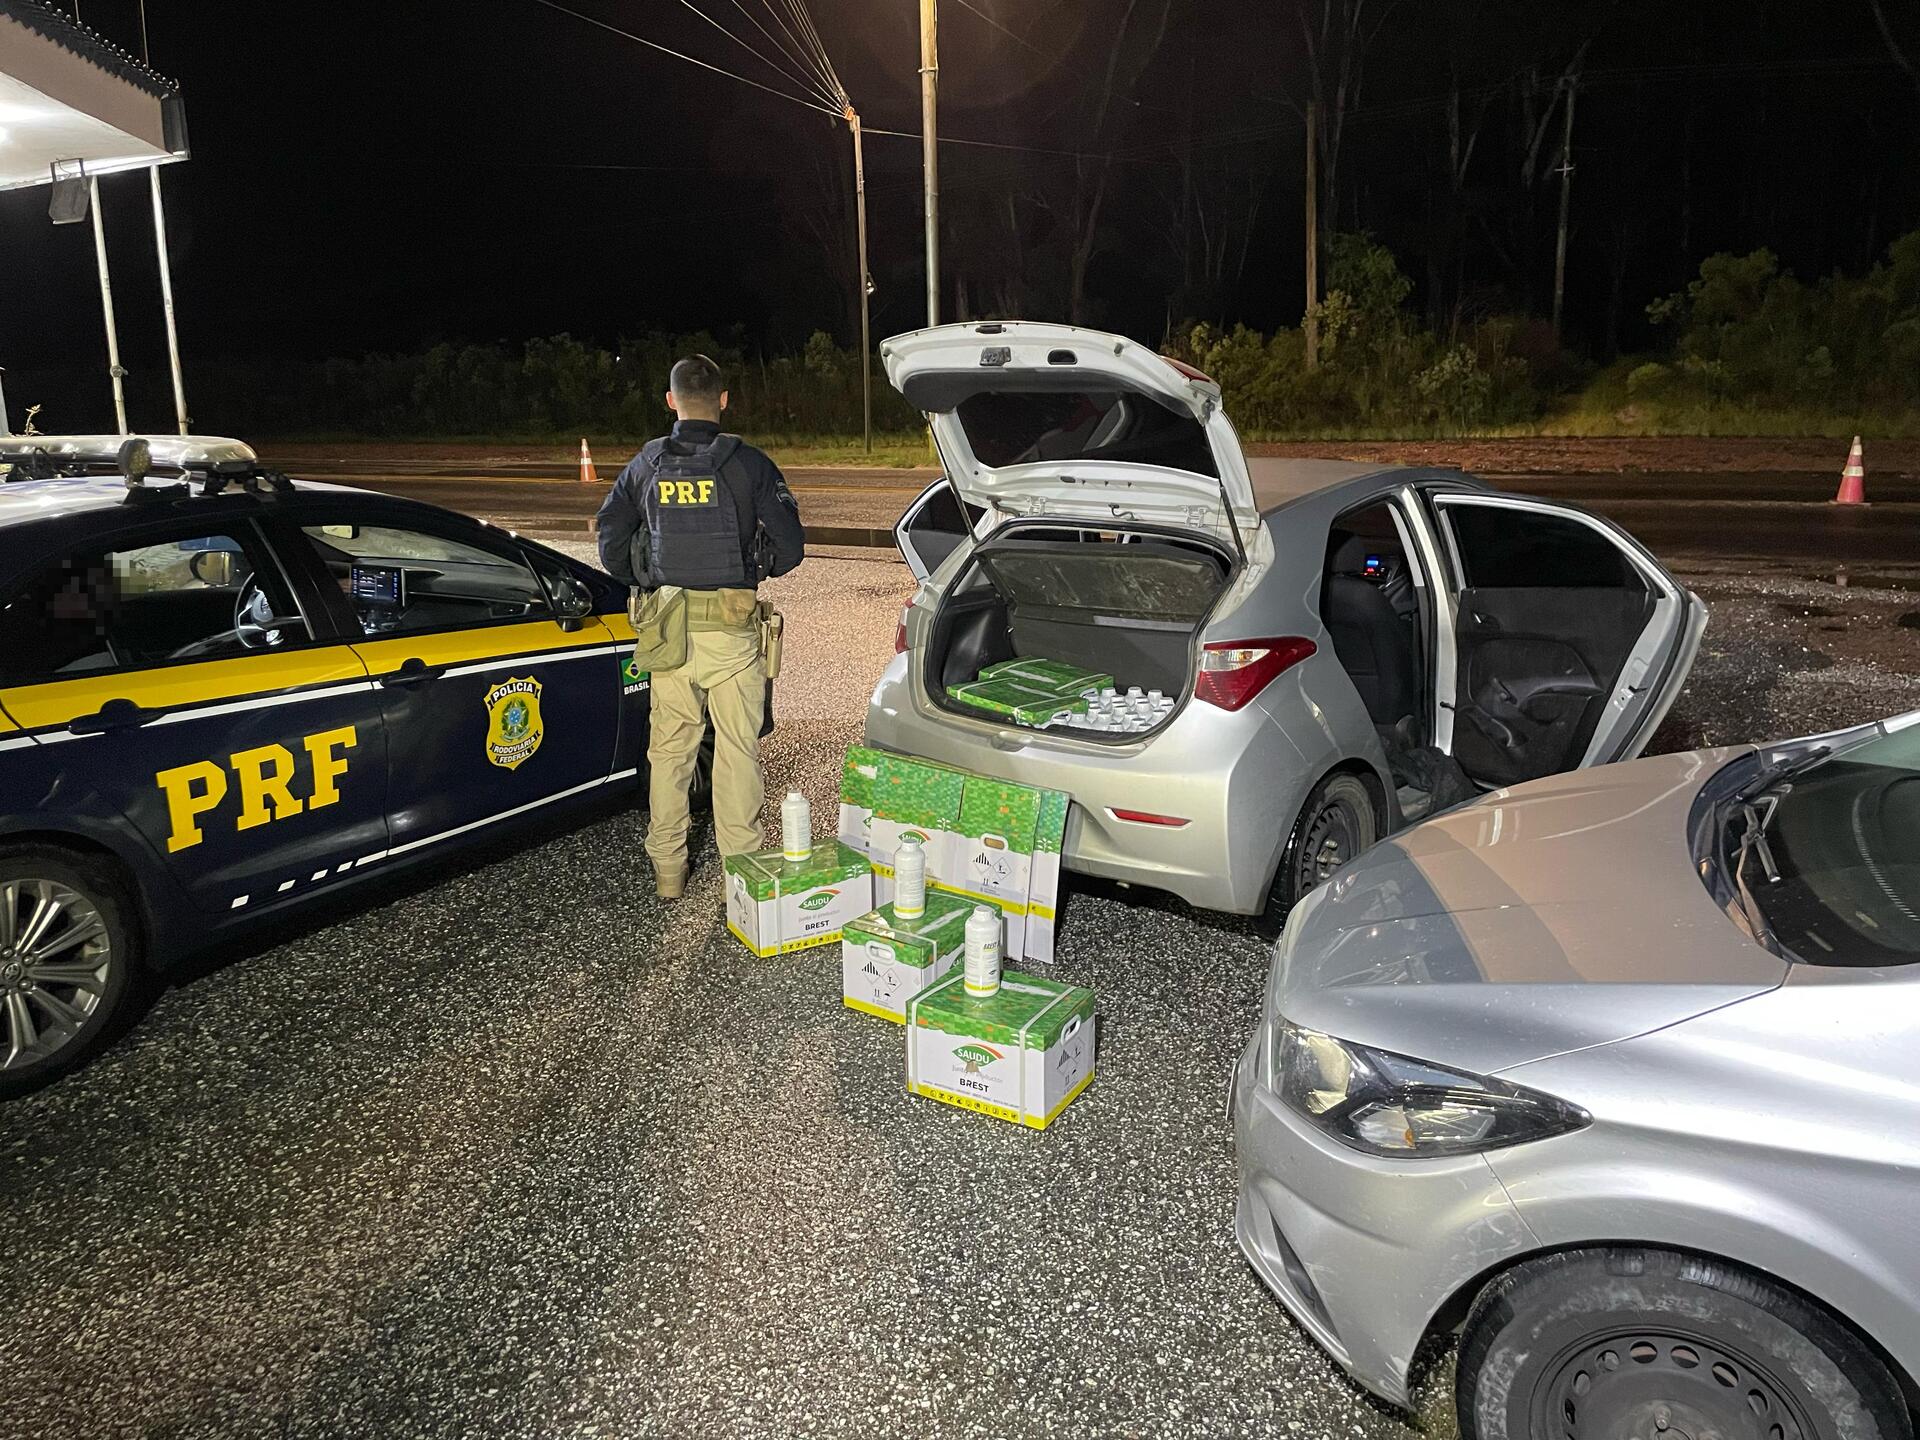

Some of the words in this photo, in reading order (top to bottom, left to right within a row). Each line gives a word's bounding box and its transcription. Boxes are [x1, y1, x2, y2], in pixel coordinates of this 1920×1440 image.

[658, 480, 714, 504] PRF
[623, 680, 650, 696] BRASIL
[499, 749, 530, 764] FEDERAL
[156, 725, 358, 854] PRF
[803, 897, 829, 908] SAUDU
[805, 920, 830, 930] BREST
[957, 1048, 990, 1065] SAUDU
[959, 1078, 990, 1093] BREST
